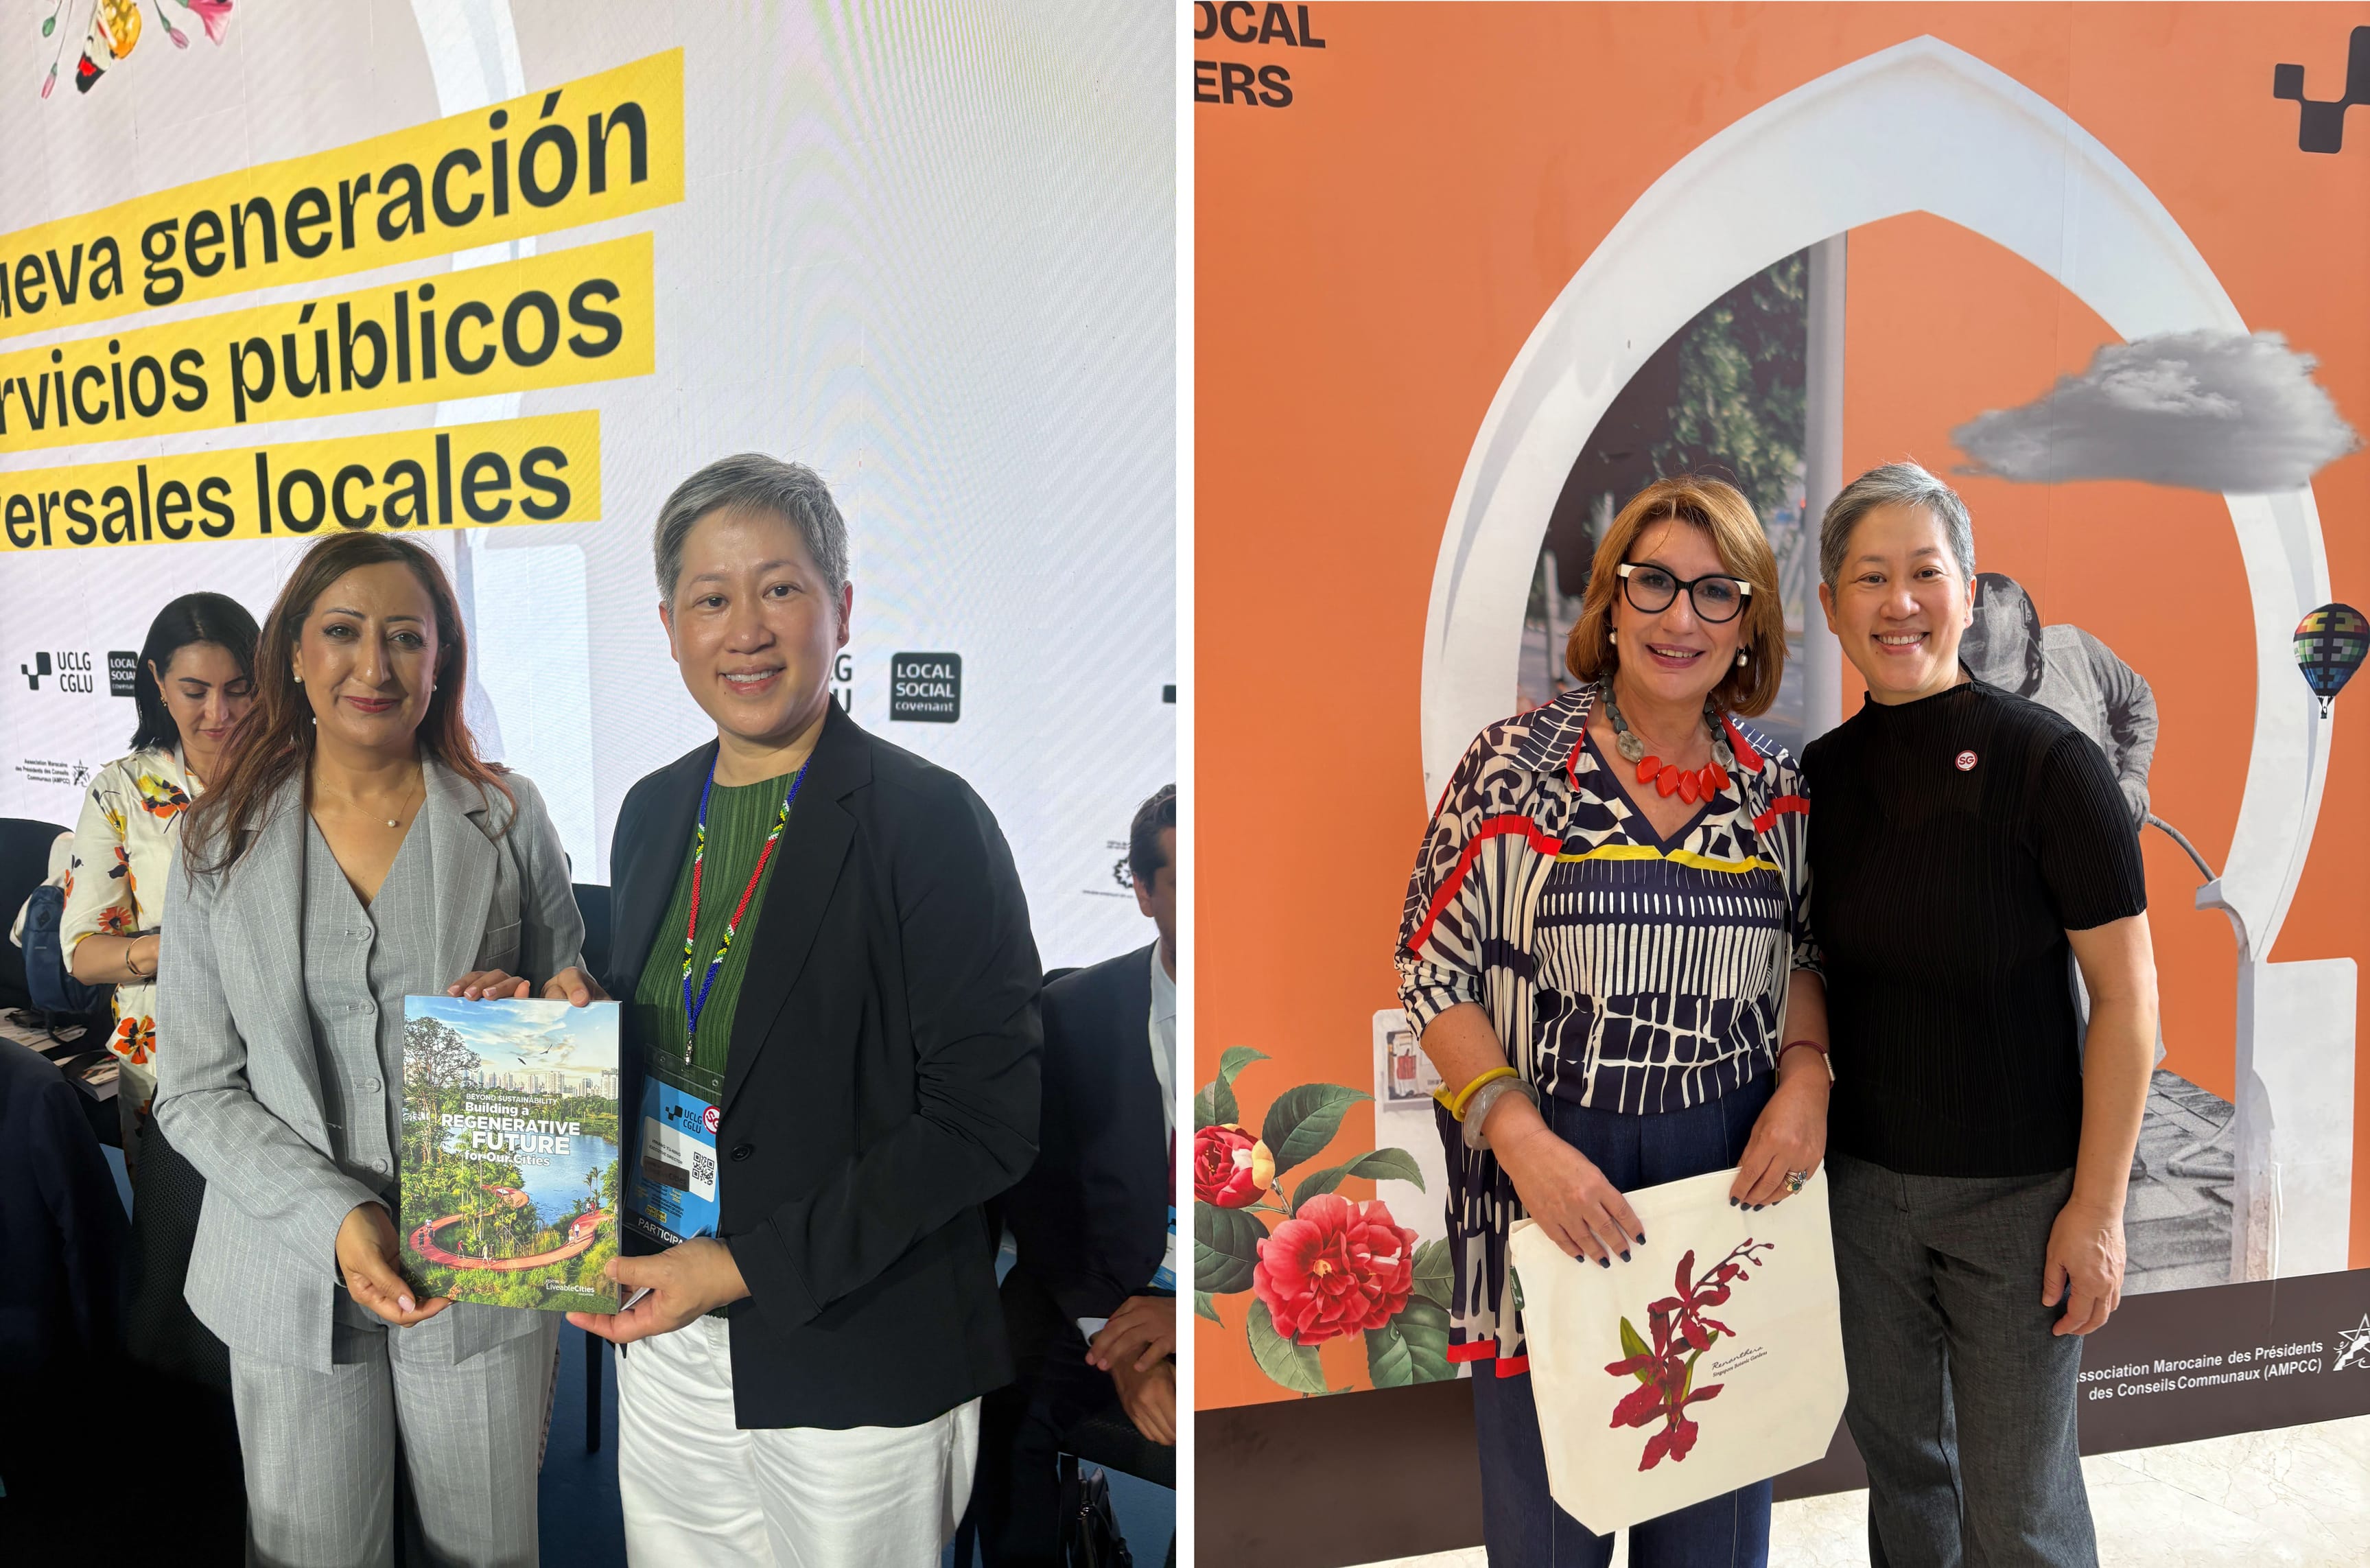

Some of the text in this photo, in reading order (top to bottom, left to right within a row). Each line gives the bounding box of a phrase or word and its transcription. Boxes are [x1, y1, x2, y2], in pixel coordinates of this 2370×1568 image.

[1194, 60, 1293, 108] ERS
[141, 89, 649, 307] generación
[230, 277, 624, 423] públicos
[0, 433, 572, 548] ersales locales
[57, 651, 92, 671] UCLG
[110, 658, 137, 668] LOCAL
[897, 663, 955, 679] LOCAL
[60, 673, 93, 693] CGLU
[895, 682, 955, 699] SOCIAL
[895, 701, 954, 712] covenant
[1958, 756, 1975, 765] SG
[465, 1101, 530, 1116] Building a
[466, 1093, 558, 1105] BEYOND SUSTAINABILITY
[441, 1113, 580, 1136] REGENERATIVE
[683, 1119, 701, 1134] CGLU
[684, 1109, 703, 1125] UCLG
[471, 1130, 571, 1156] FUTURE
[465, 1149, 550, 1167] for Our Cities
[637, 1217, 684, 1245] PARTICIPA
[1711, 1346, 1764, 1371] Renanthera
[2076, 1341, 2324, 1383] ssociation Marocaine des Présidents
[2088, 1357, 2323, 1401] des Conseils Communaux (AMPCC)
